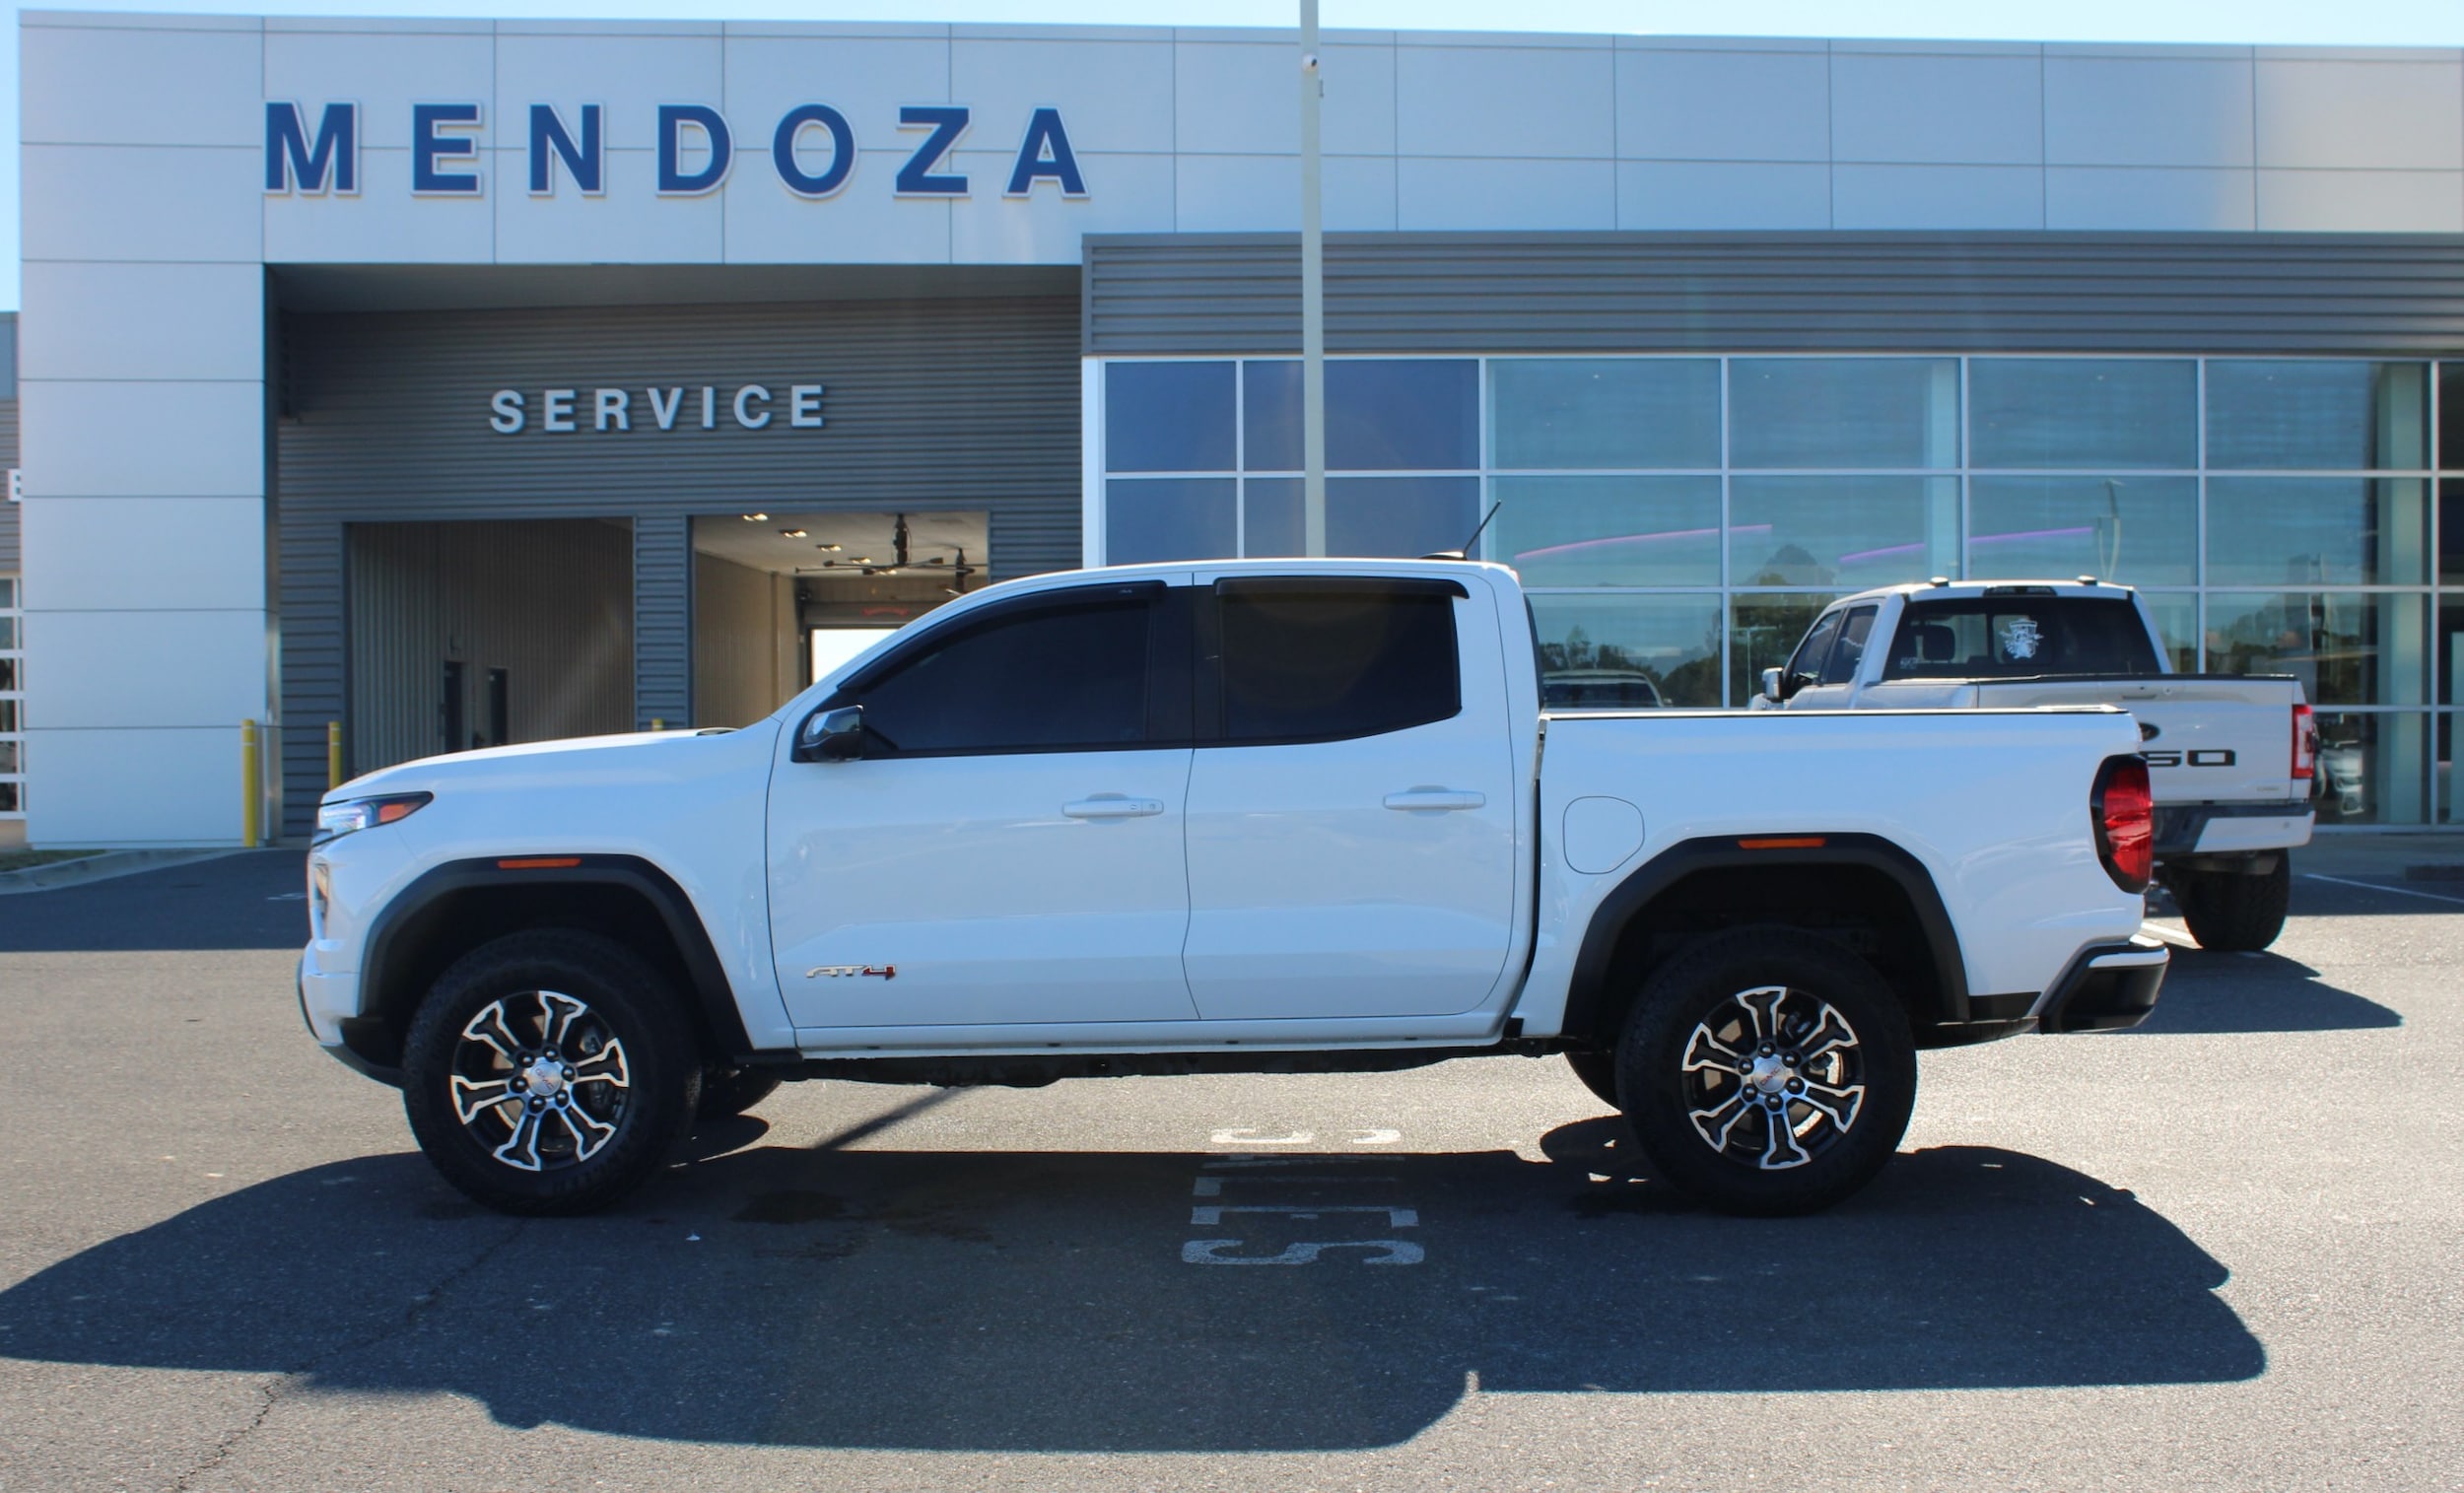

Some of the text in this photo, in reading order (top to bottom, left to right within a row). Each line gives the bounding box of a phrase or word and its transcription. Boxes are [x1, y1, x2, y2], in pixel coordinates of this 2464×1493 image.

[262, 100, 1089, 196] MENDOZA
[490, 383, 824, 434] SERVICE
[805, 965, 896, 980] AT4
